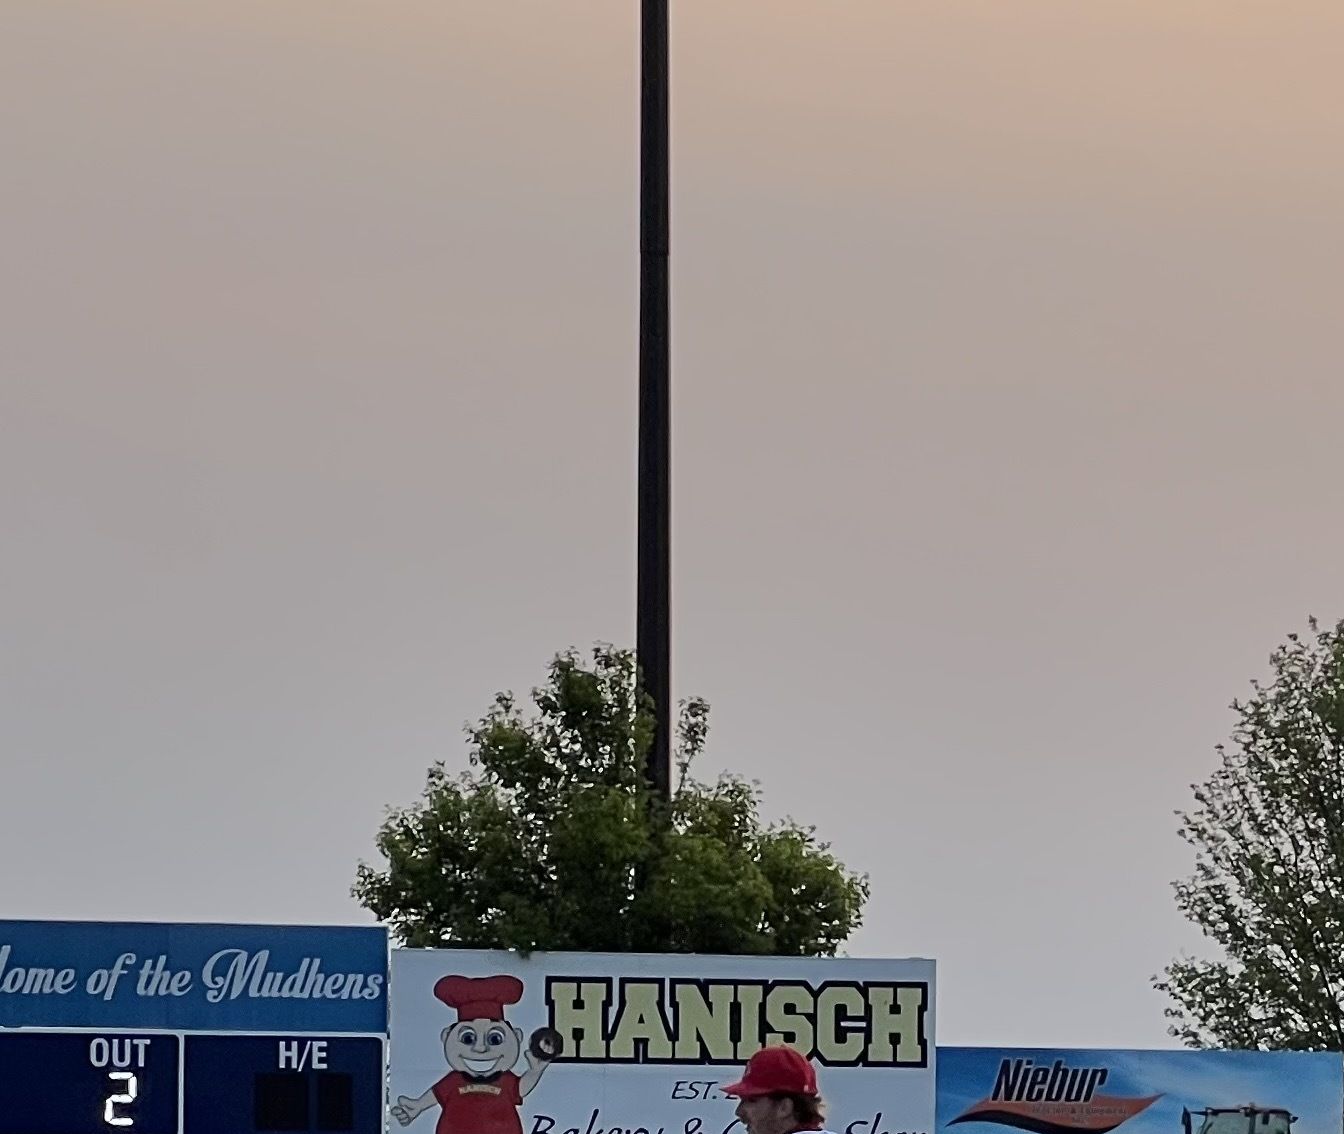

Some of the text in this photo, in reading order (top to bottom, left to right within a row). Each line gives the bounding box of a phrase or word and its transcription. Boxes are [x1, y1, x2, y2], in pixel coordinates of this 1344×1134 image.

[86, 953, 136, 1000] of
[138, 955, 192, 997] the
[201, 949, 383, 1003] Mudhens
[545, 975, 928, 1068] HANISCH
[89, 1038, 150, 1067] OUT
[278, 1041, 328, 1071] H/E
[104, 1071, 137, 1125] 2
[671, 1080, 718, 1100] EST.
[992, 1058, 1108, 1103] Niebur
